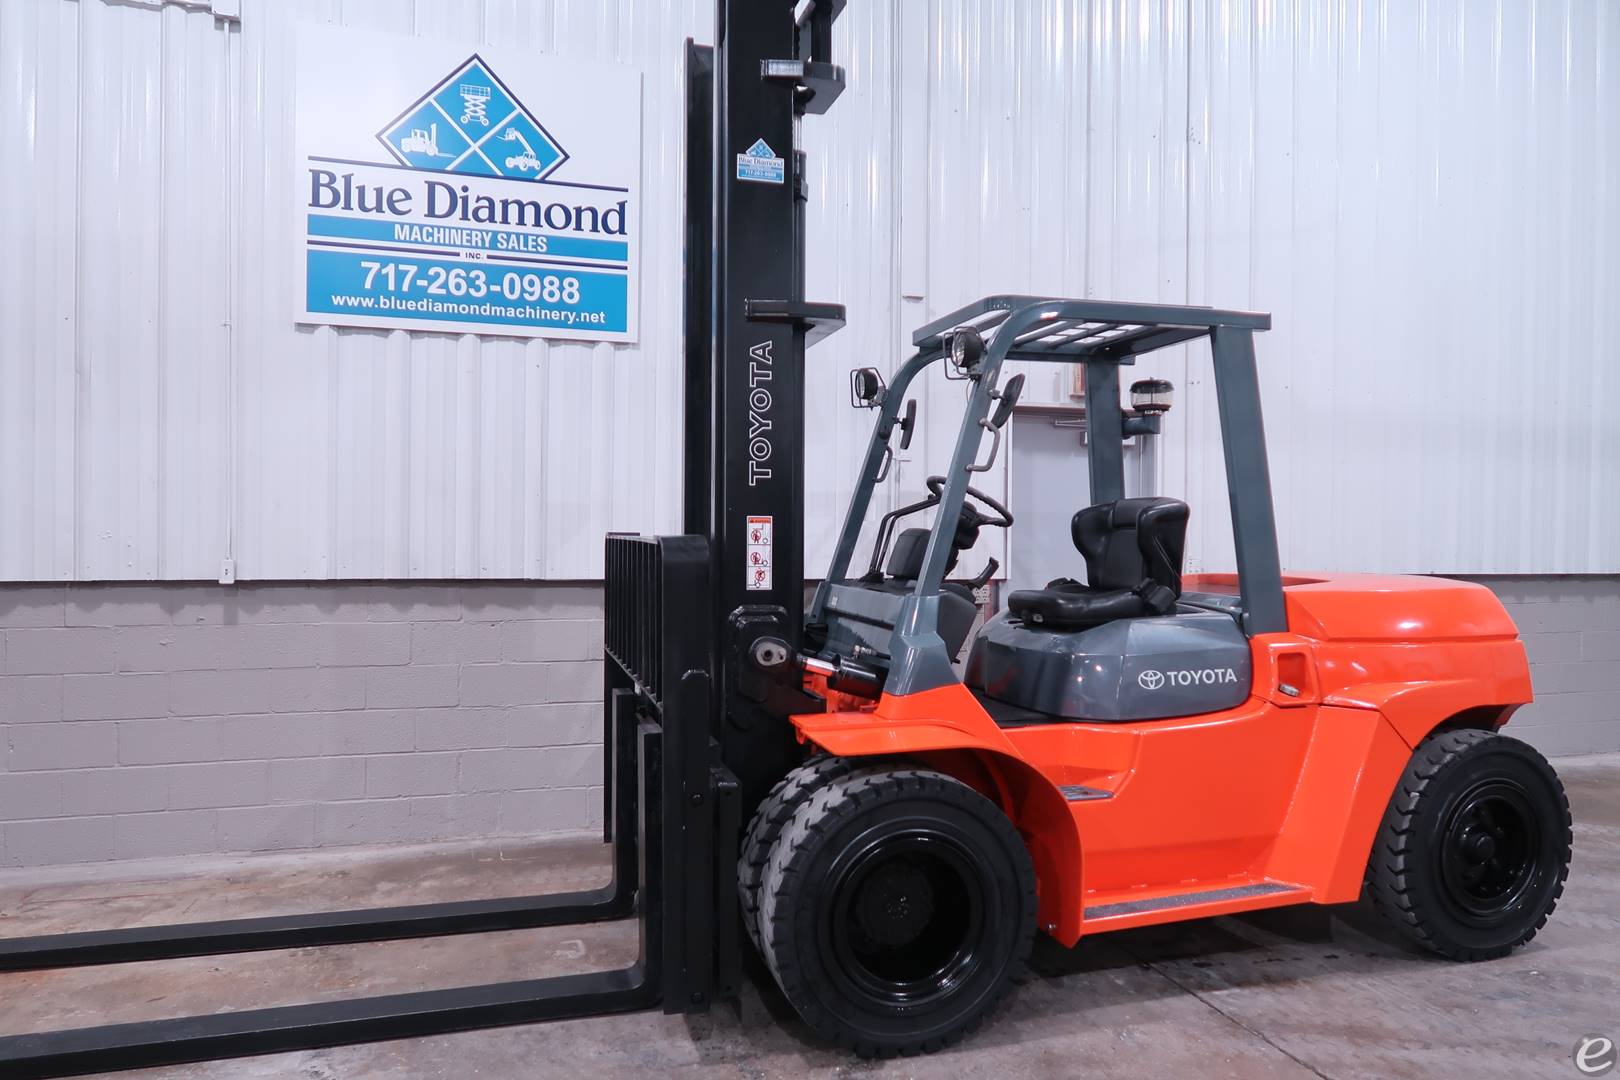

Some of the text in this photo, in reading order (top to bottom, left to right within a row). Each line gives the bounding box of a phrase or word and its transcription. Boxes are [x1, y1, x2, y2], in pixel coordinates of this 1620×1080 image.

[308, 168, 628, 236] Blue Diamond
[394, 223, 548, 253] MACHINERY SALES
[465, 252, 484, 260] INC.
[360, 261, 581, 304] 717-263-0988
[331, 294, 606, 325] www.bluediamondmachinery.net
[749, 340, 772, 487] TOYOTA
[1166, 668, 1238, 686] TOYOTA
